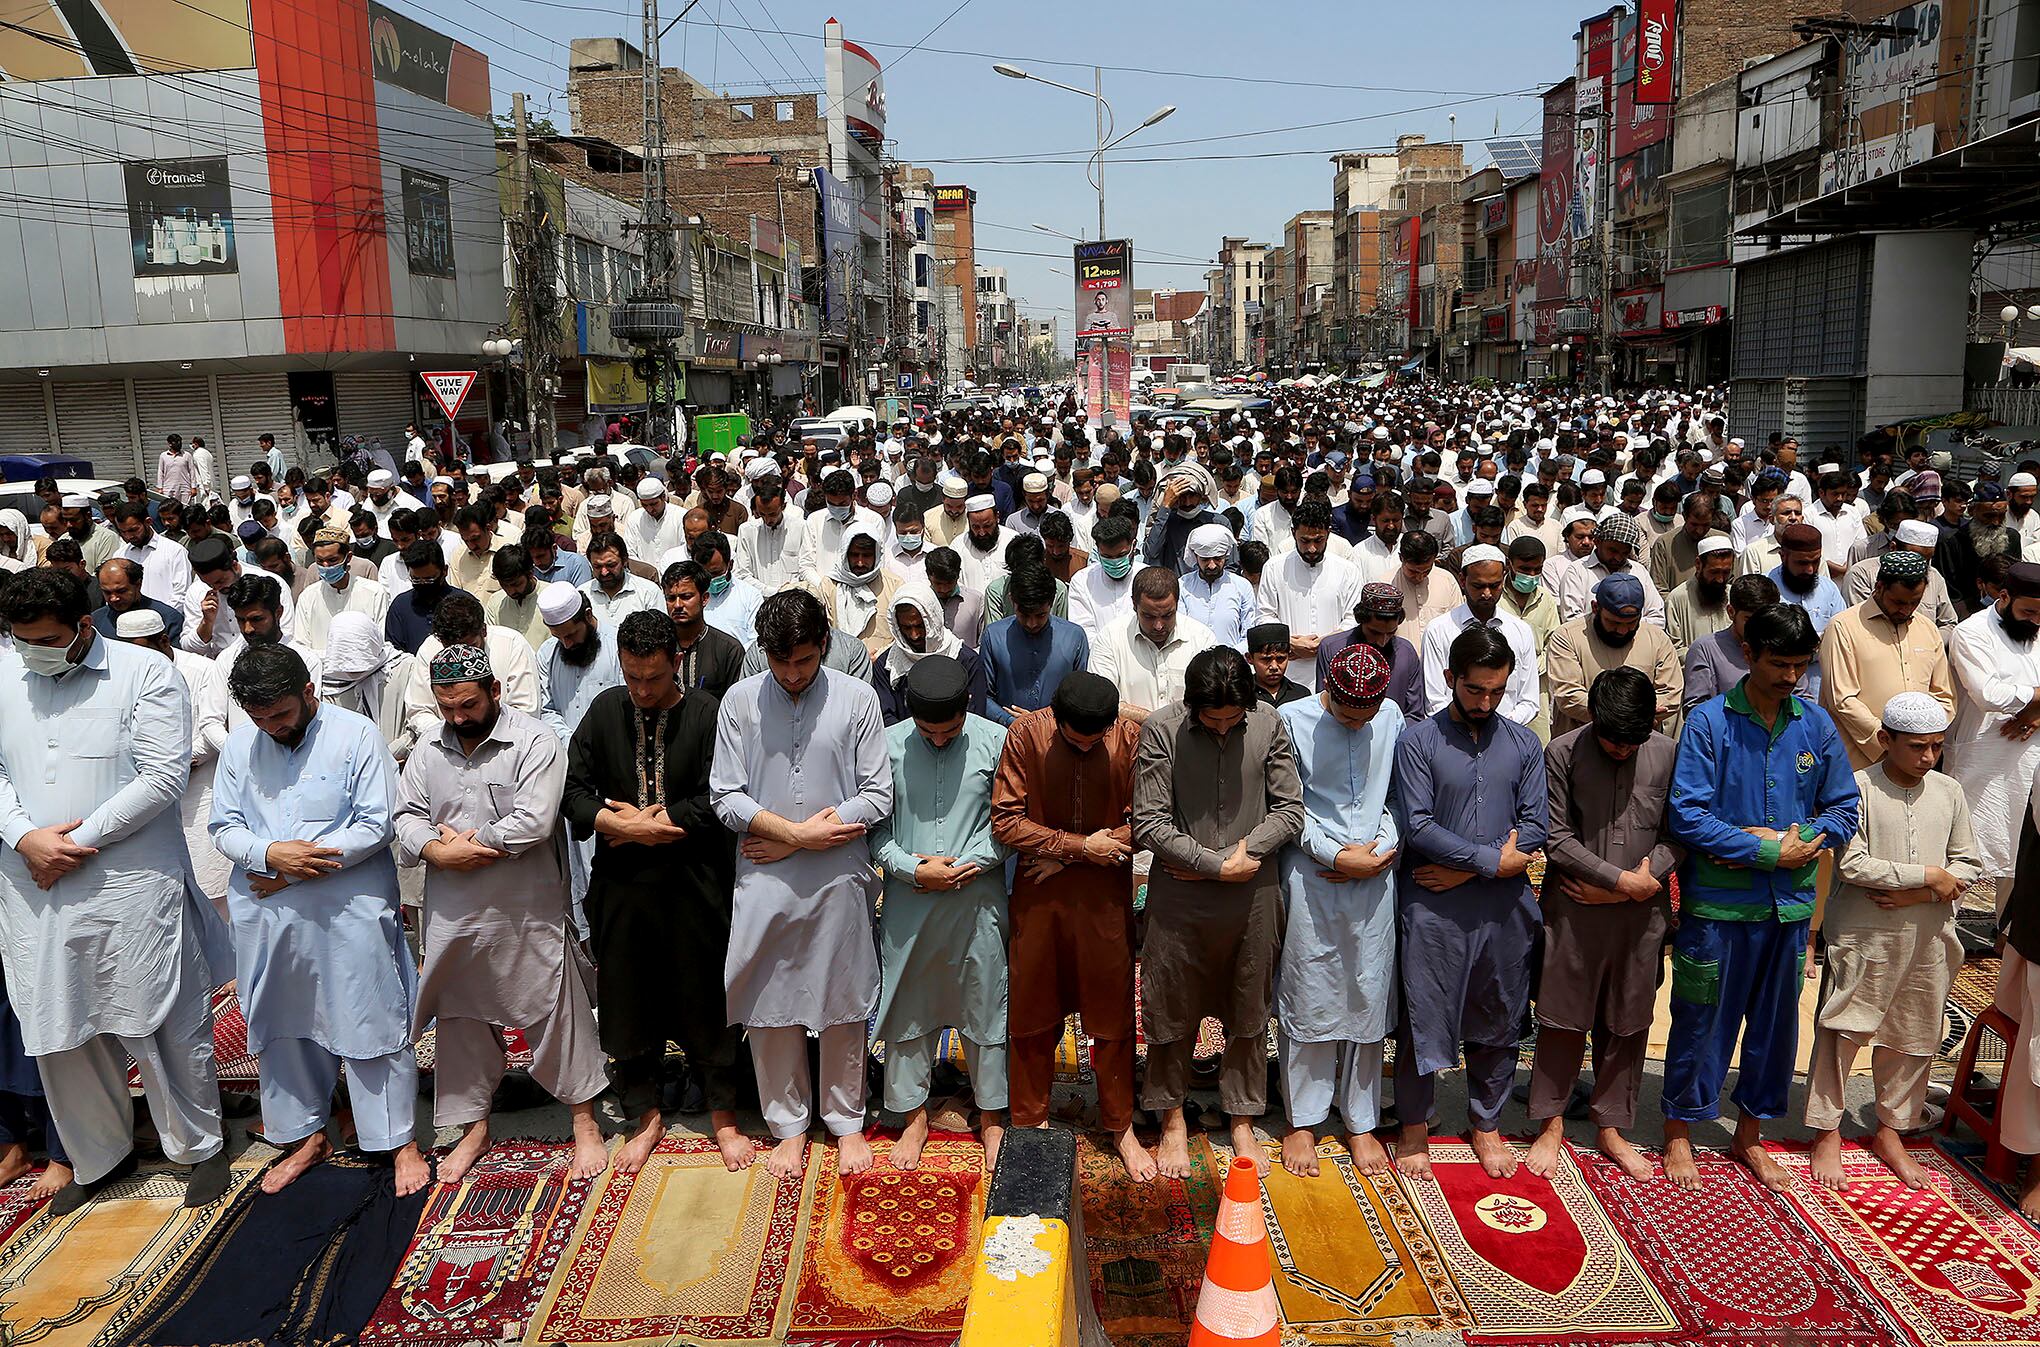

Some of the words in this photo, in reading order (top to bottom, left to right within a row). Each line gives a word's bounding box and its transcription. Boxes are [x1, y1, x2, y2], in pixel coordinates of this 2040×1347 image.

[1868, 146, 1886, 161] STORE
[936, 188, 964, 200] ZAFAR
[436, 378, 462, 387] GIVE
[900, 375, 910, 387] P
[440, 387, 460, 396] WAY
